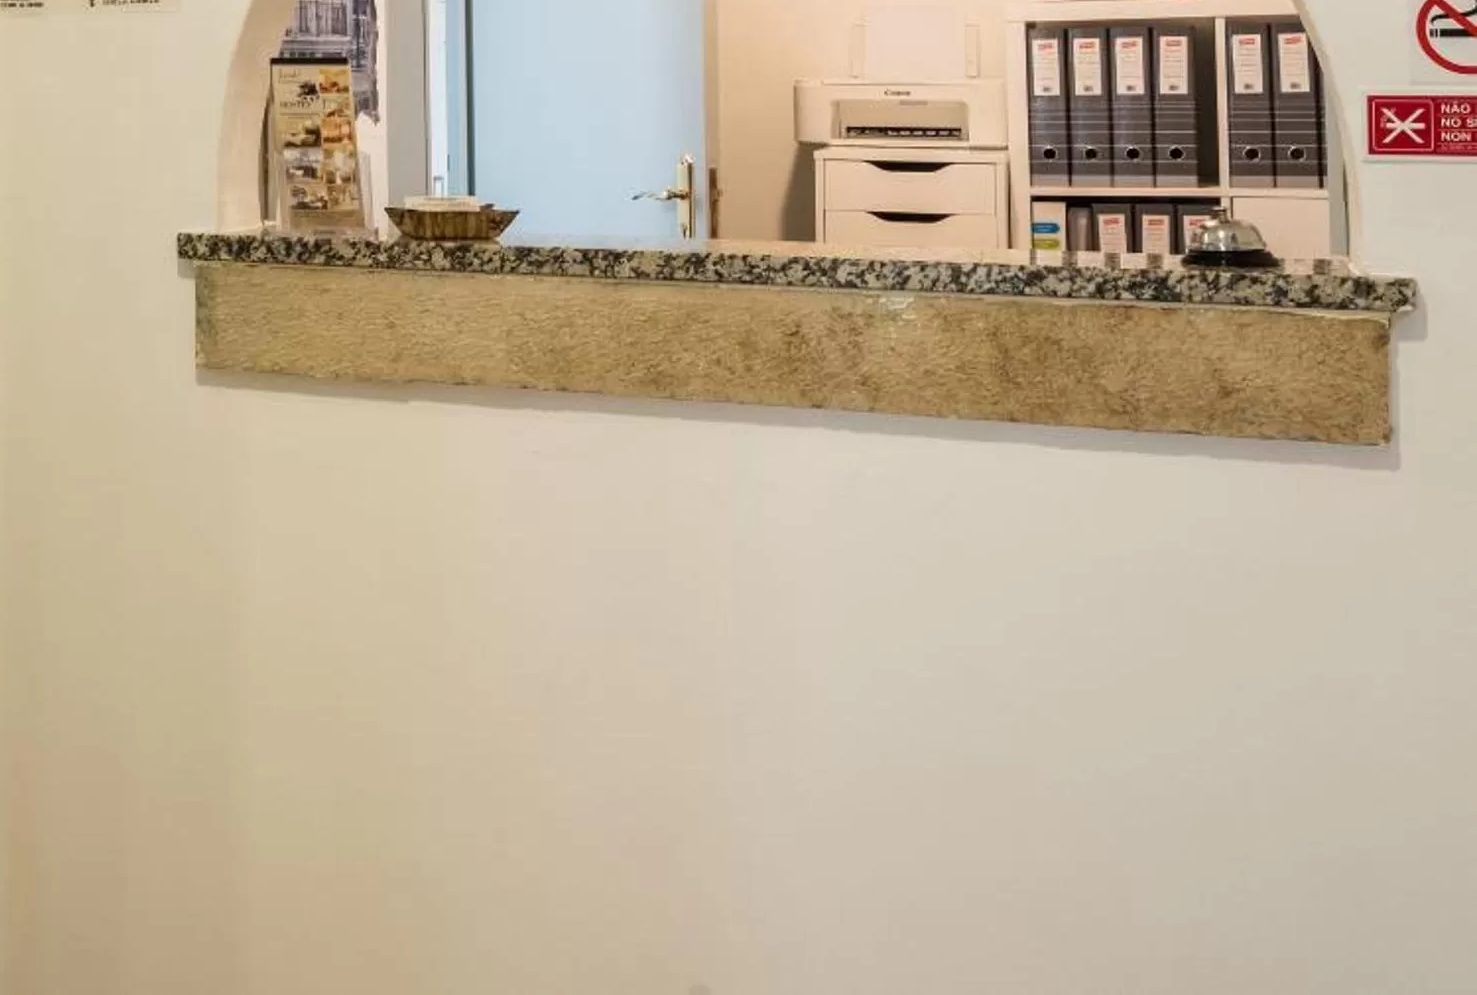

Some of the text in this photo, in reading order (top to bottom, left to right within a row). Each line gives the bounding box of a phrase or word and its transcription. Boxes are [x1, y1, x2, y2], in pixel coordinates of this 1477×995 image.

[1441, 101, 1471, 113] NÃO
[1441, 118, 1462, 128] NO
[1441, 132, 1472, 142] NON
